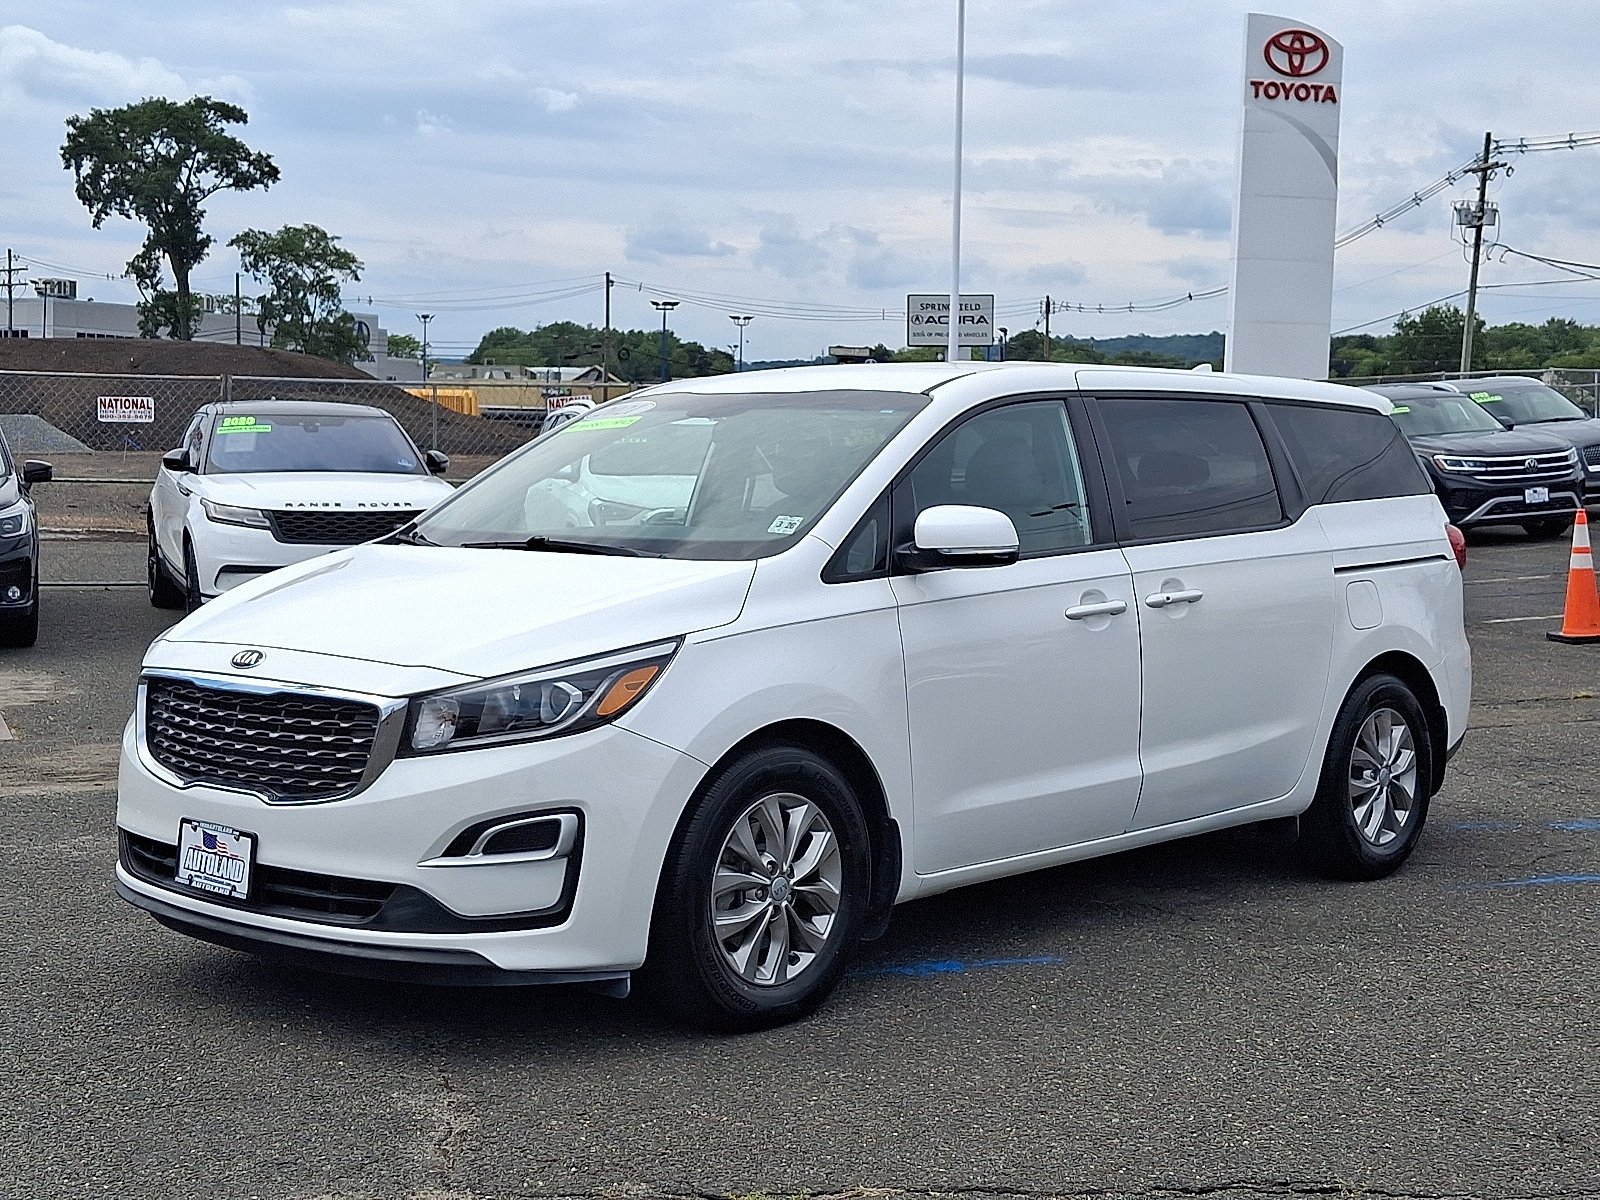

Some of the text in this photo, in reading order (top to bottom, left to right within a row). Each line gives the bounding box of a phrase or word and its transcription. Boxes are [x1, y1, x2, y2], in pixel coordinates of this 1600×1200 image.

[1250, 81, 1337, 103] TOYOTA
[920, 303, 980, 311] SPRINIELD
[924, 315, 989, 325] ACRA
[99, 398, 153, 410] NATIONAL
[232, 650, 261, 665] KIA
[183, 848, 245, 882] AUTOLAND
[191, 881, 230, 895] AUTOLAND
